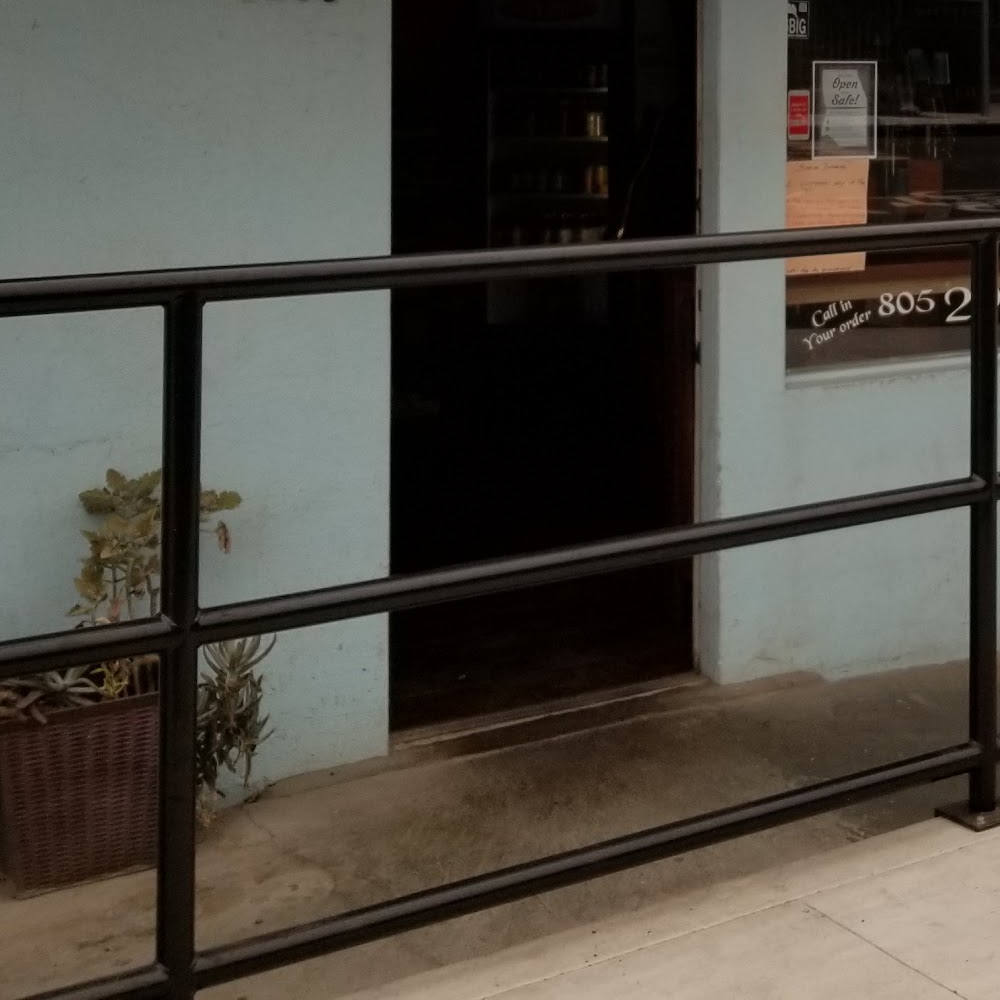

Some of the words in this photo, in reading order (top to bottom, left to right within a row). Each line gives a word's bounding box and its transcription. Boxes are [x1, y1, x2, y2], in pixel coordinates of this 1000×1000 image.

[833, 77, 858, 90] Open
[831, 95, 859, 105] Safe!
[811, 303, 838, 327] Call
[839, 300, 853, 313] in
[878, 289, 935, 317] 805
[803, 327, 837, 351] Your
[838, 309, 872, 333] order
